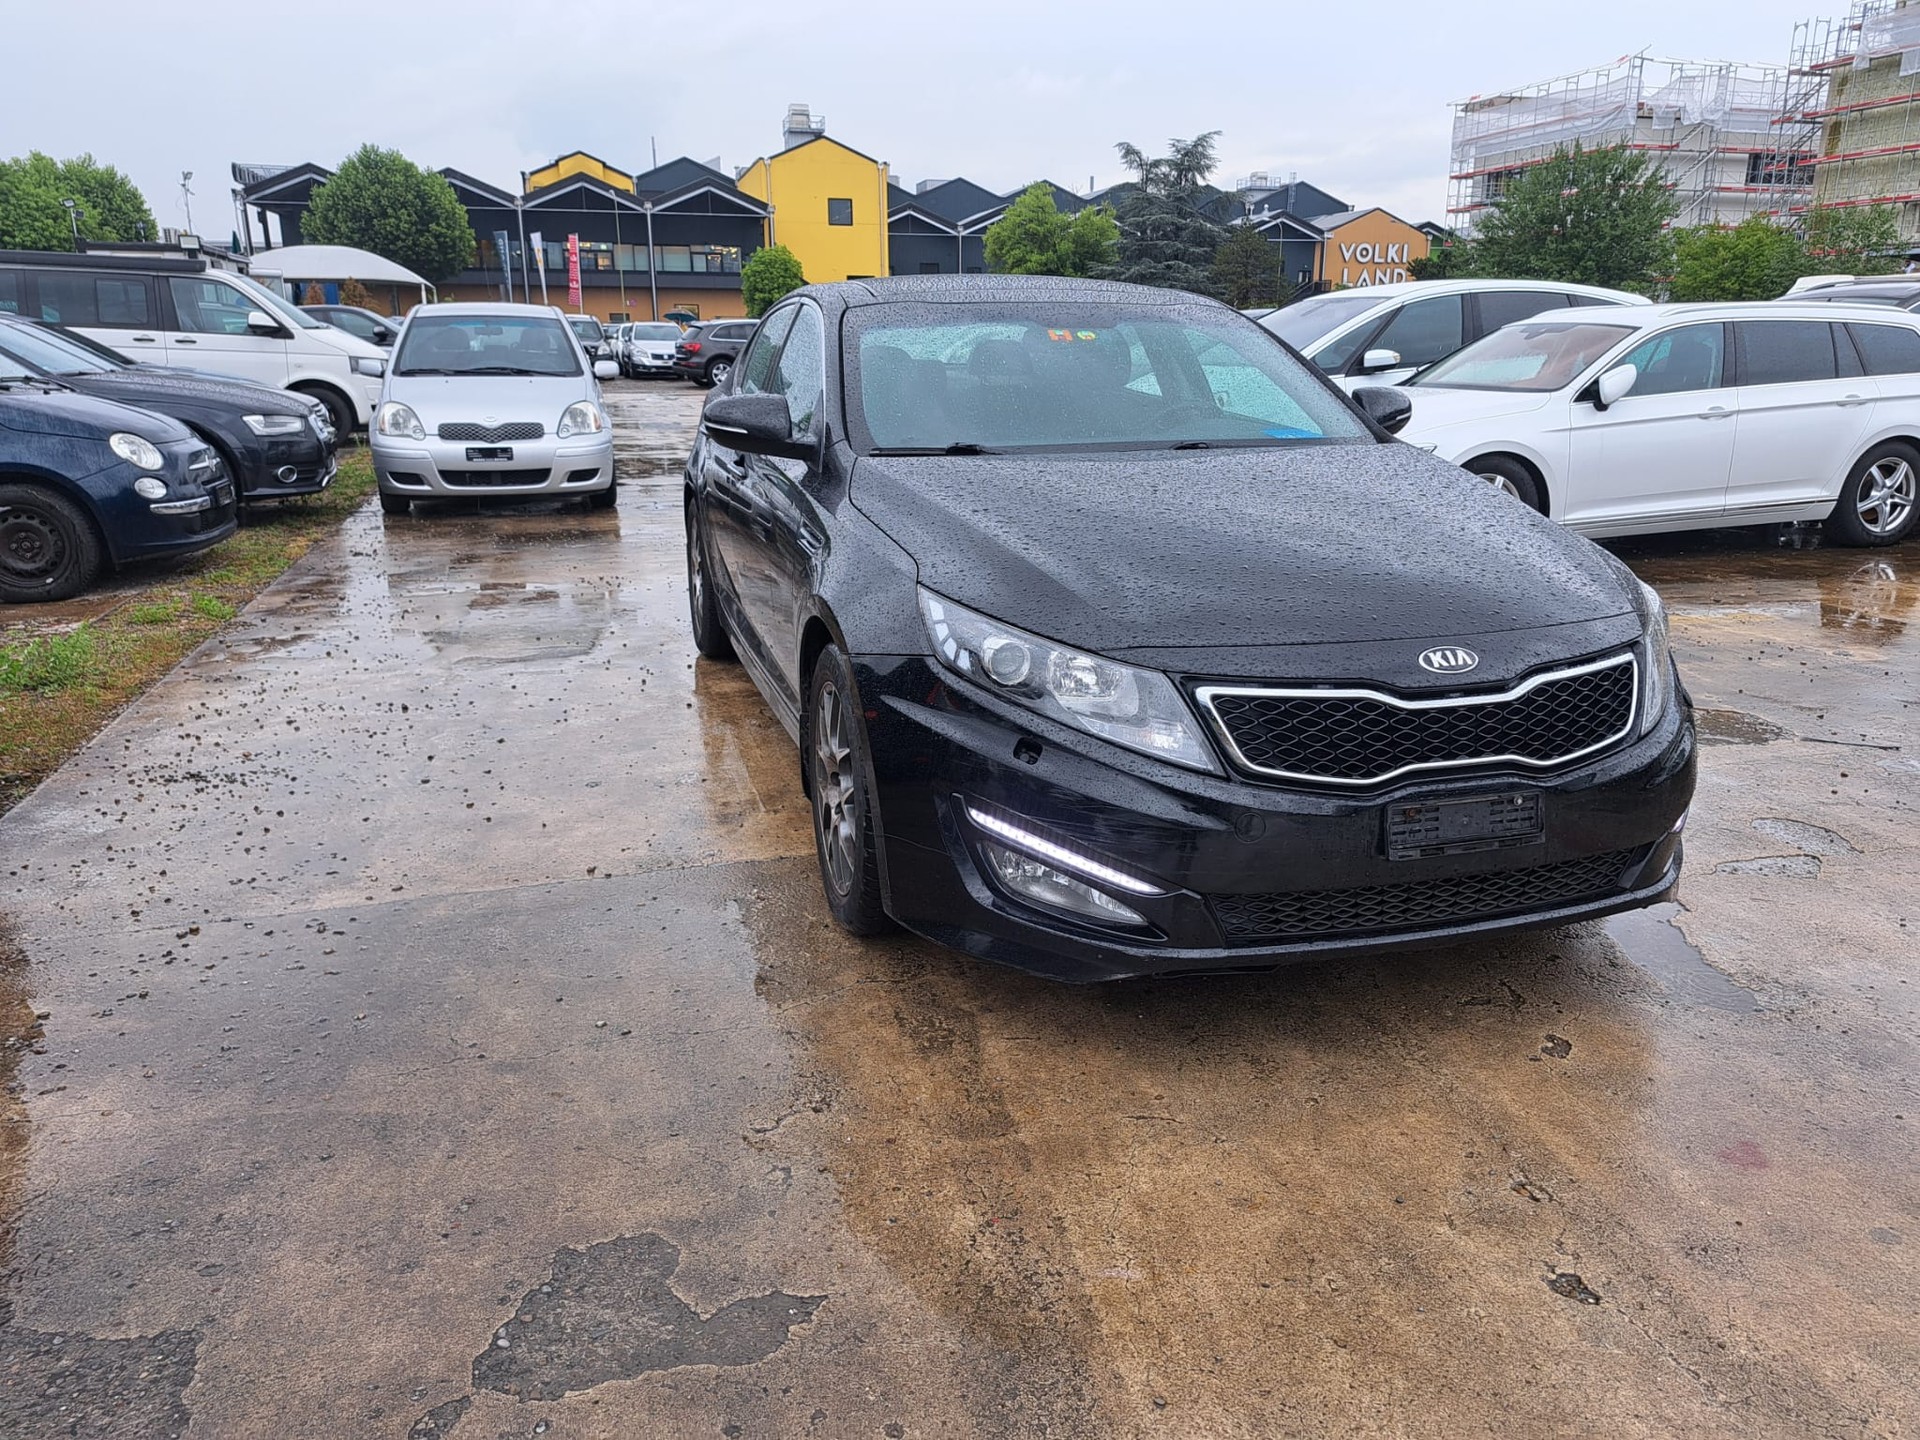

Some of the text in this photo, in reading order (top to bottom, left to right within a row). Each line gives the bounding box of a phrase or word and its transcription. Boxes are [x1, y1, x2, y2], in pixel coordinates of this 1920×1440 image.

[1339, 243, 1408, 263] VOLKI
[1342, 268, 1406, 287] LAND
[1427, 650, 1473, 668] KIA
